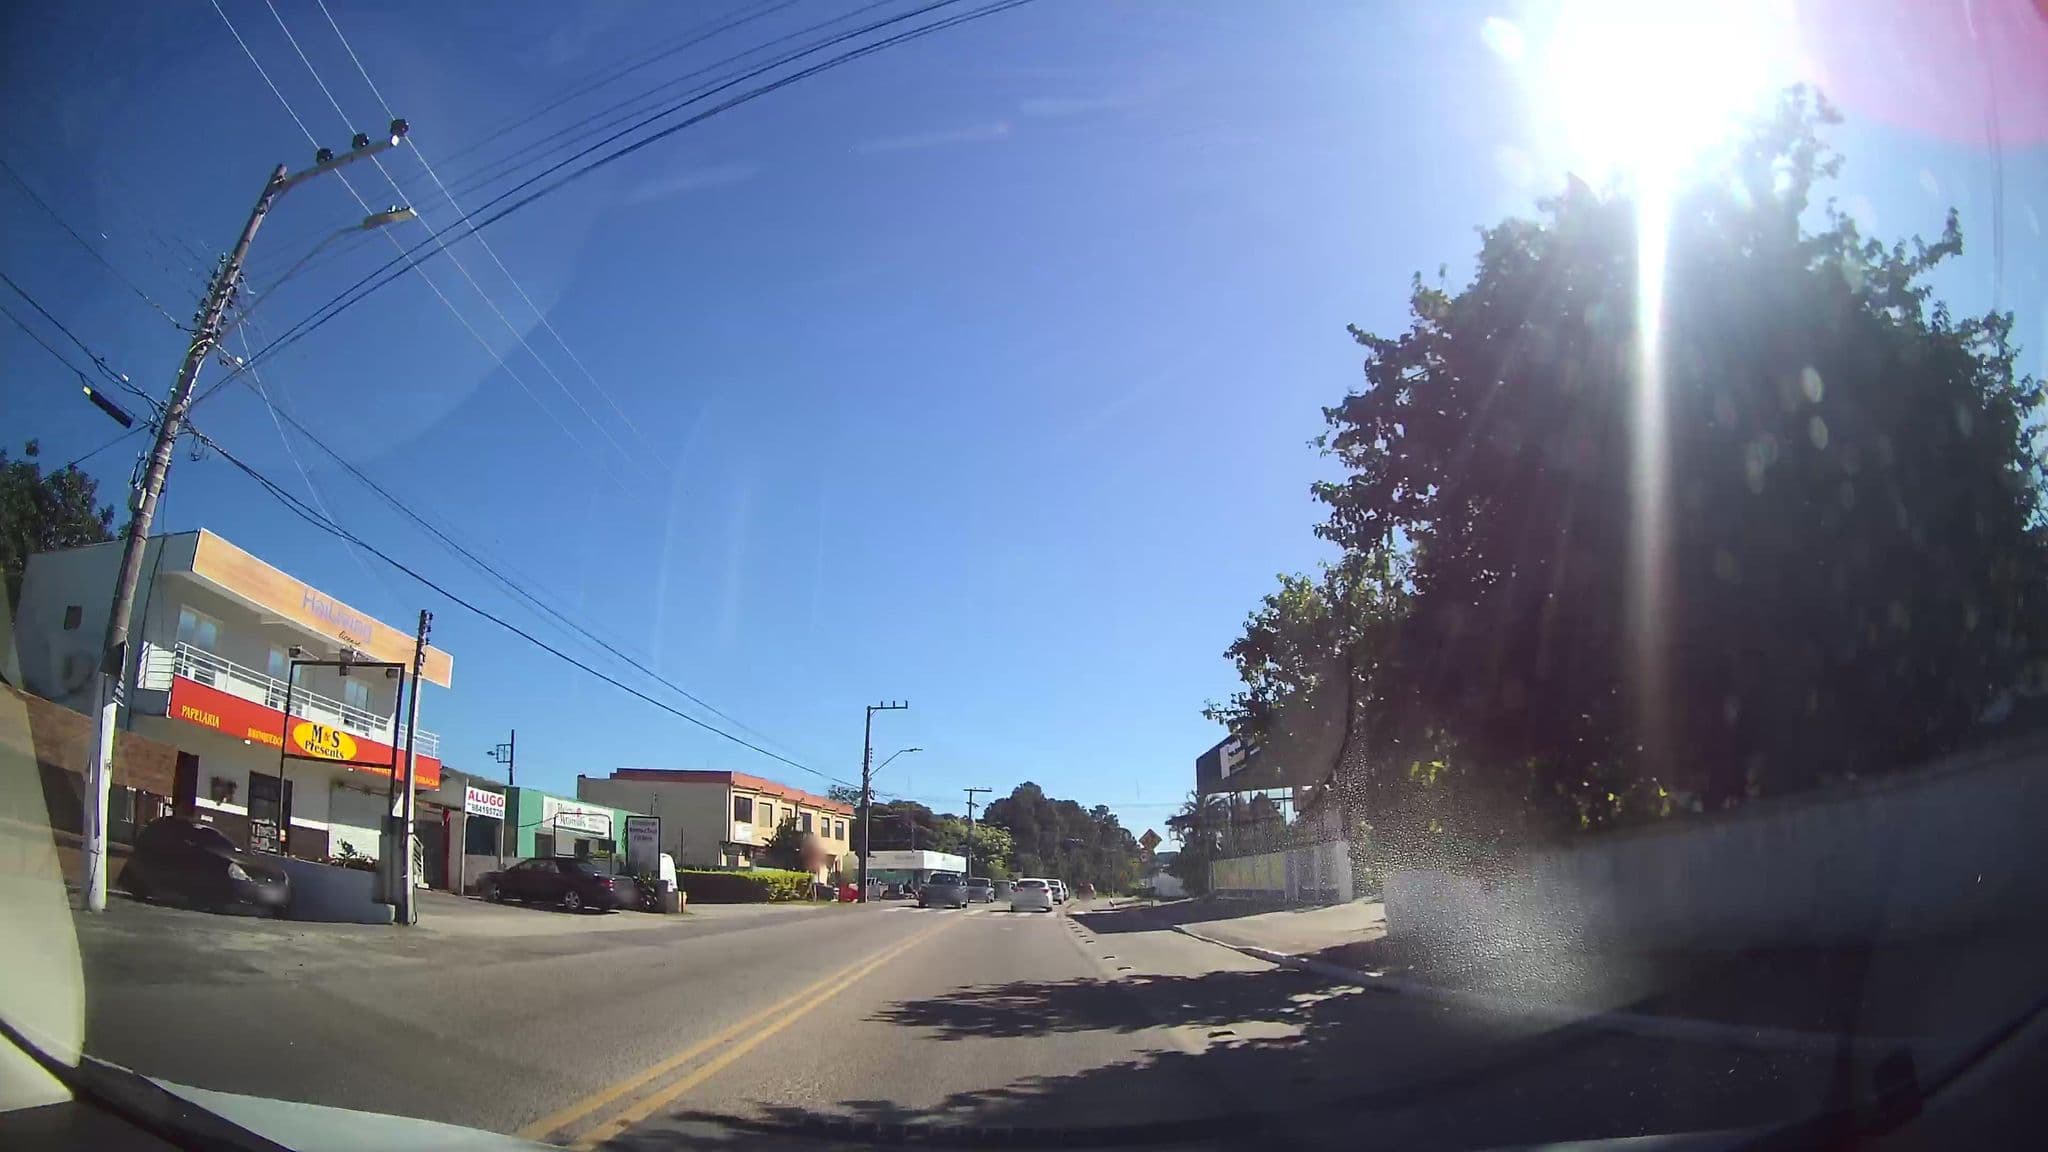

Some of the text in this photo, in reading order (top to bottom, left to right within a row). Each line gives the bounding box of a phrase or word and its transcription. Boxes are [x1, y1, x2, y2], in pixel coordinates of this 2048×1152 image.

[181, 705, 220, 728] PAPELARIA
[311, 724, 323, 744] M
[331, 730, 340, 748] S
[304, 740, 344, 759] Presents
[468, 789, 504, 808] ALUGO
